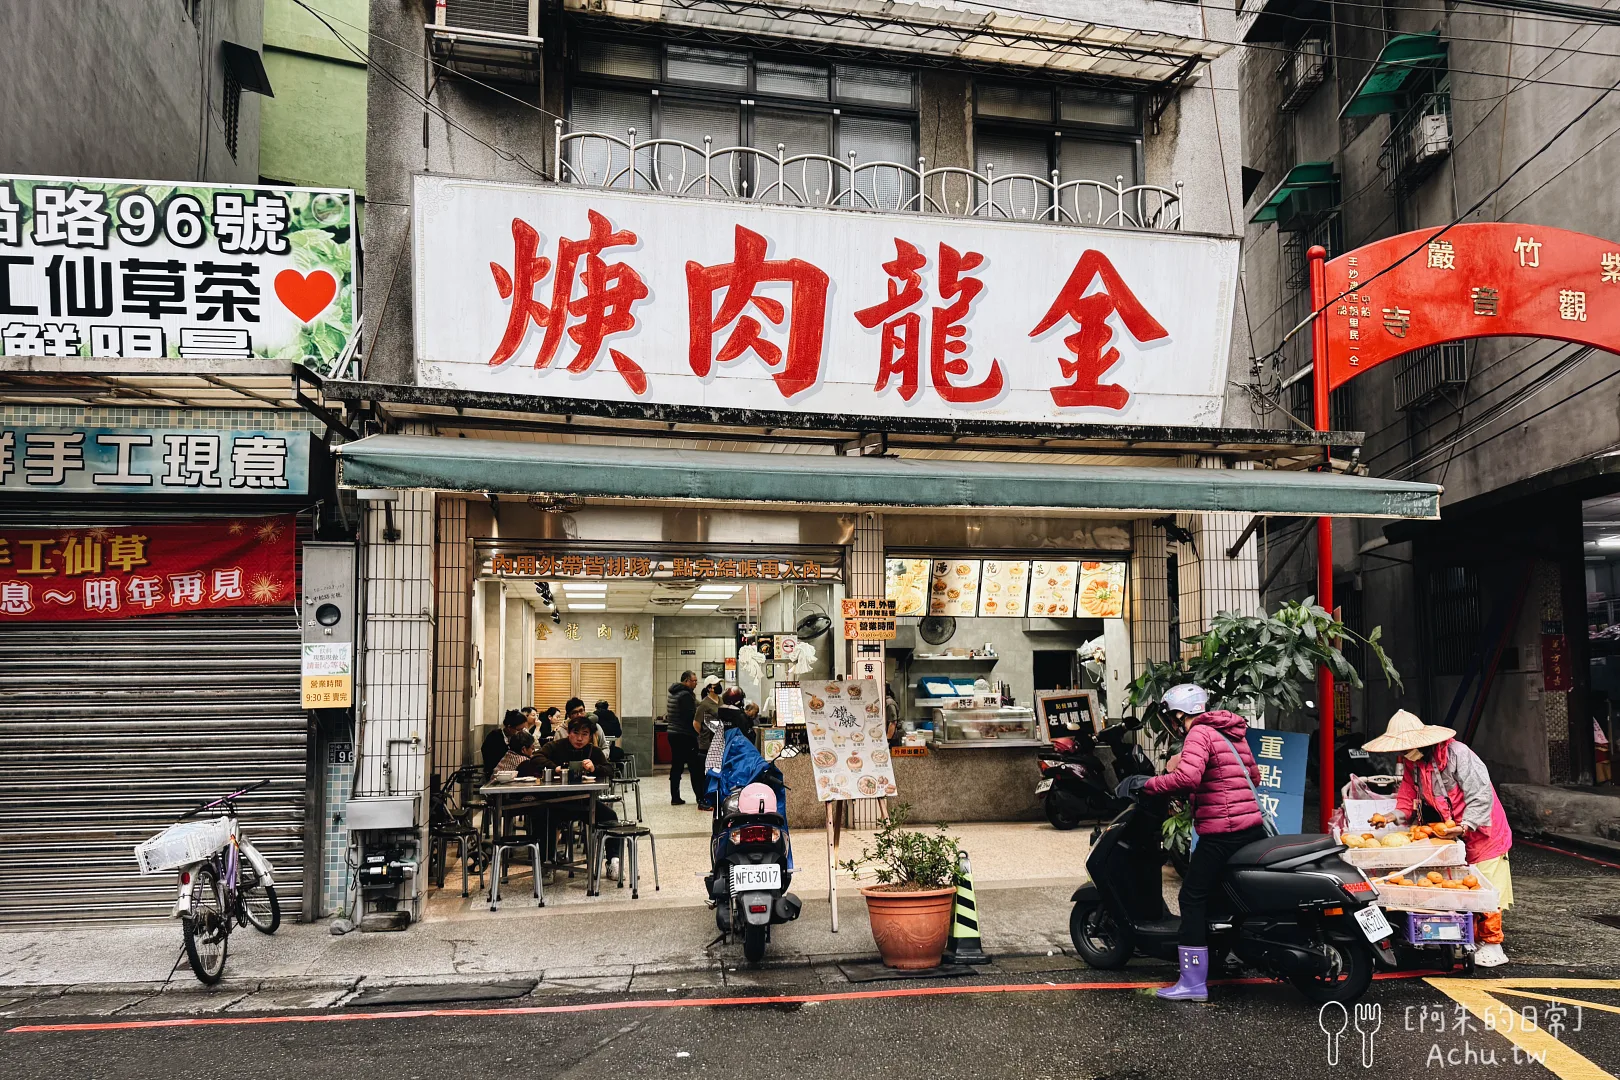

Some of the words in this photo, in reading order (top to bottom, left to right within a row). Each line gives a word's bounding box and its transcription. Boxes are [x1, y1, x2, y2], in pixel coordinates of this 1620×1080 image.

[0, 430, 289, 489] 手工現煮
[0, 534, 148, 575] 工仙草
[859, 621, 895, 631] 營業時間
[310, 680, 343, 689] 營業時間
[305, 693, 322, 702] 9:30
[323, 692, 331, 702] 至
[332, 692, 348, 702] 賣完
